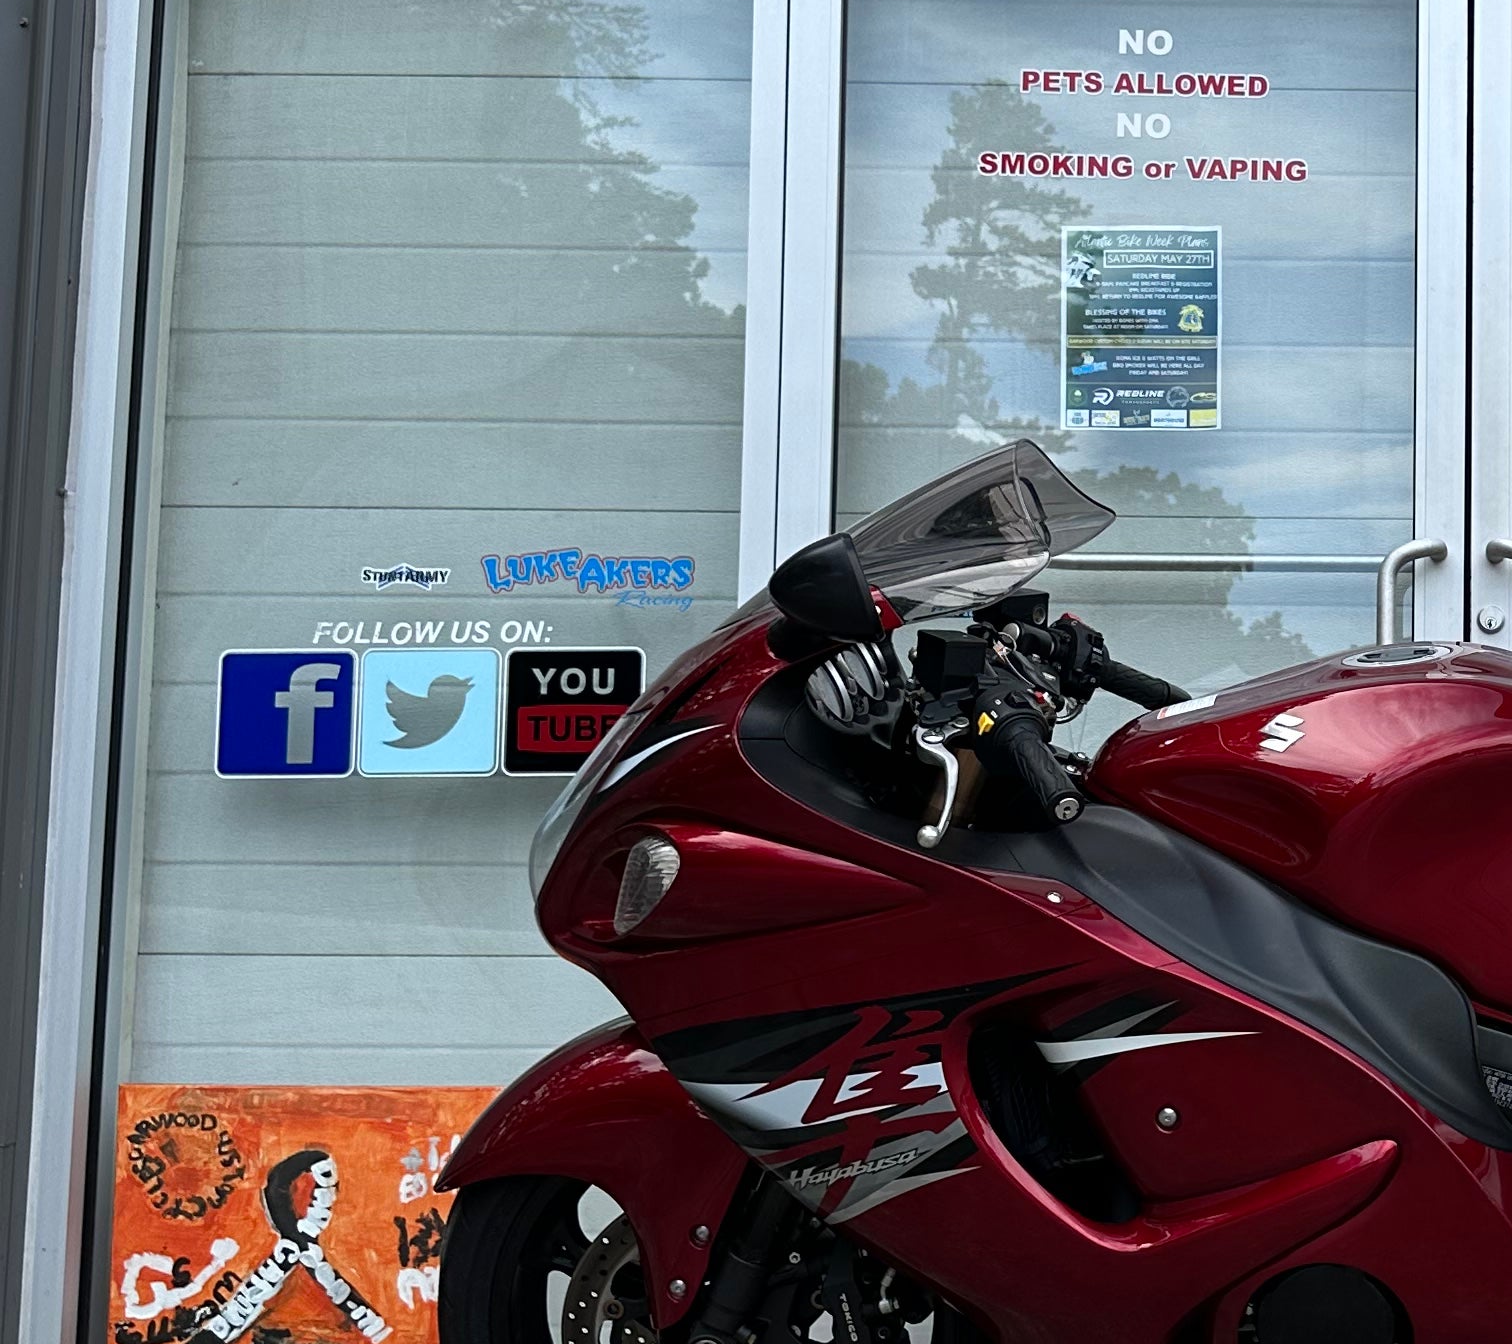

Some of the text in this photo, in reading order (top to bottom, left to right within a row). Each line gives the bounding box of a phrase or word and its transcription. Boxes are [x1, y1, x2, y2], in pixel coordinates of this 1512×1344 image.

[1117, 29, 1173, 56] NO
[1020, 69, 1270, 98] PETS ALLOWED
[1115, 112, 1172, 139] NO
[977, 152, 1309, 183] SMOKING or VAPING
[1116, 233, 1142, 248] Bike
[1145, 234, 1175, 248] Week
[1107, 254, 1210, 265] SATURDAY MAY 27TH
[1116, 389, 1165, 398] REDLINE
[610, 589, 694, 612] Racing
[312, 621, 554, 645] FOLLOW US ON:
[531, 667, 616, 696] YOU
[788, 1147, 919, 1190] Hayabusa
[839, 1292, 859, 1343] TOKICO
